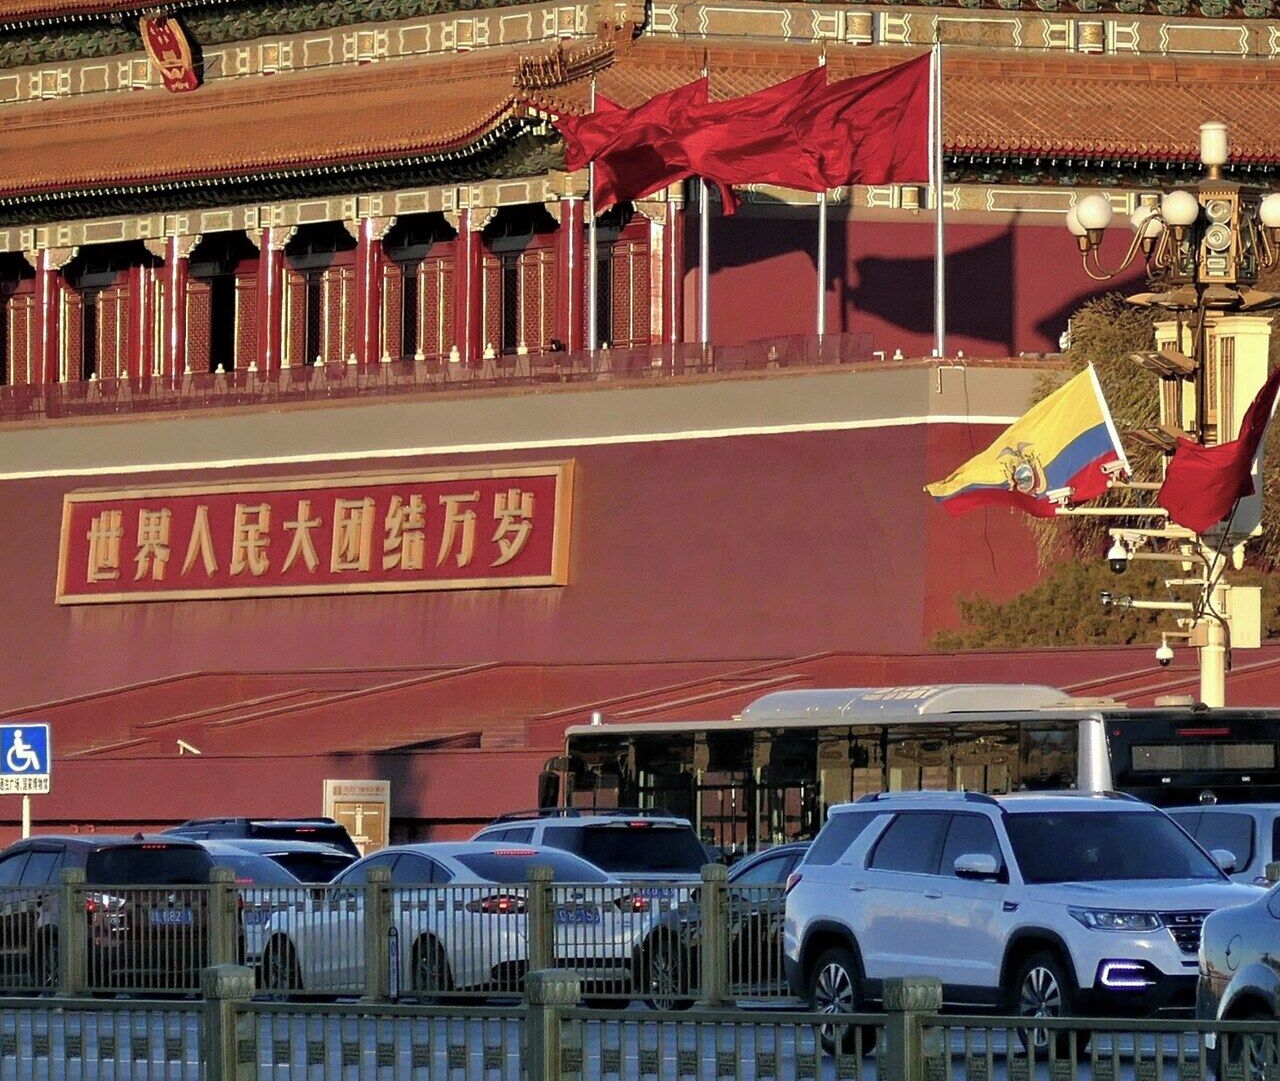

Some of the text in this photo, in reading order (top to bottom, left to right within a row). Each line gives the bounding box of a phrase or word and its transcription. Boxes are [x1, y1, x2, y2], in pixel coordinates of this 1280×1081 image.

[86, 488, 536, 583] 世界人民大团结万岁
